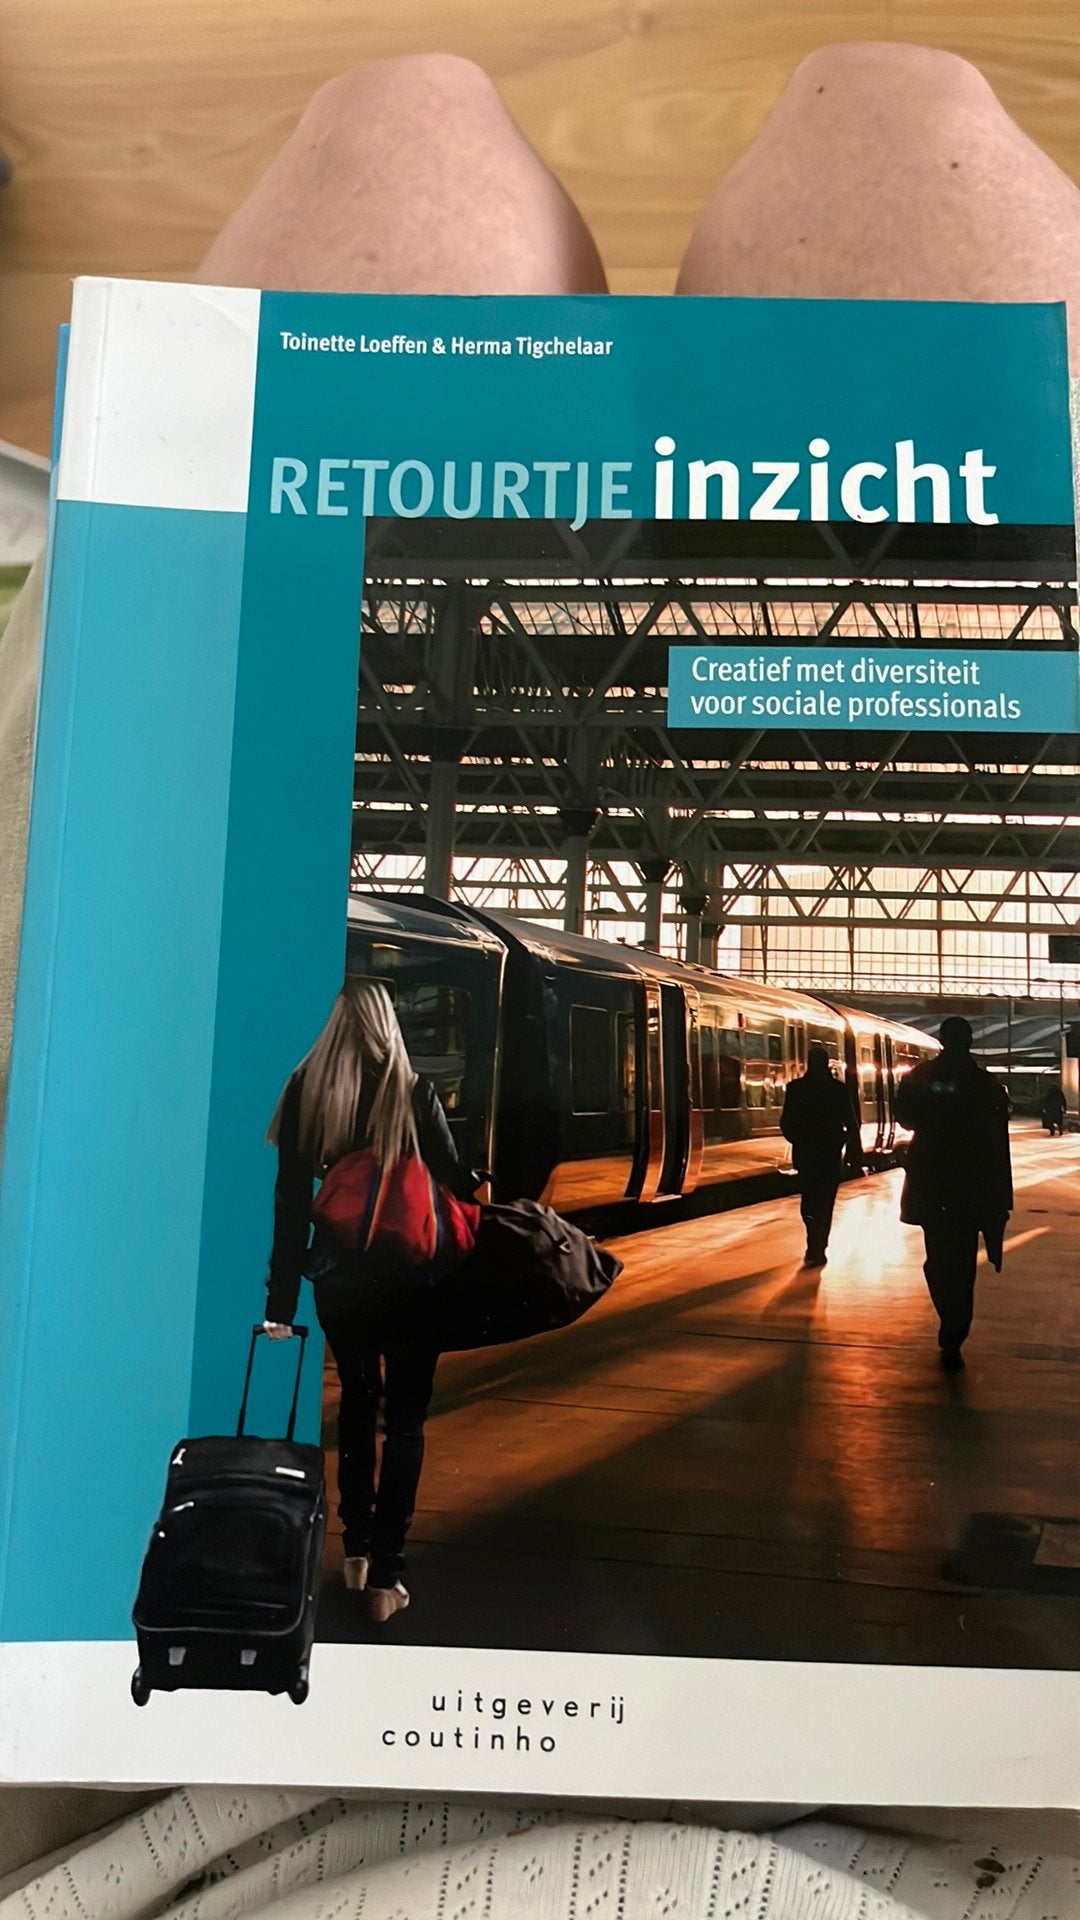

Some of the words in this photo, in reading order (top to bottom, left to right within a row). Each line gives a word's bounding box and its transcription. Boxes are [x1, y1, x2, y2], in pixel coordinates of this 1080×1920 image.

[280, 332, 356, 353] Toinette
[360, 334, 428, 355] Loeffen
[431, 337, 447, 355] &
[451, 337, 512, 356] Herma
[516, 336, 614, 359] Tigchelaar
[270, 457, 633, 532] RETOURTJE
[654, 436, 1000, 525] inzicht
[692, 655, 791, 683] Creatief
[797, 661, 844, 684] met
[851, 657, 980, 686] diversiteit
[690, 694, 748, 716] voor
[752, 689, 841, 717] sociale
[849, 691, 1021, 722] professionals
[432, 1690, 624, 1724] uitgeverij
[382, 1725, 556, 1752] coutinho
